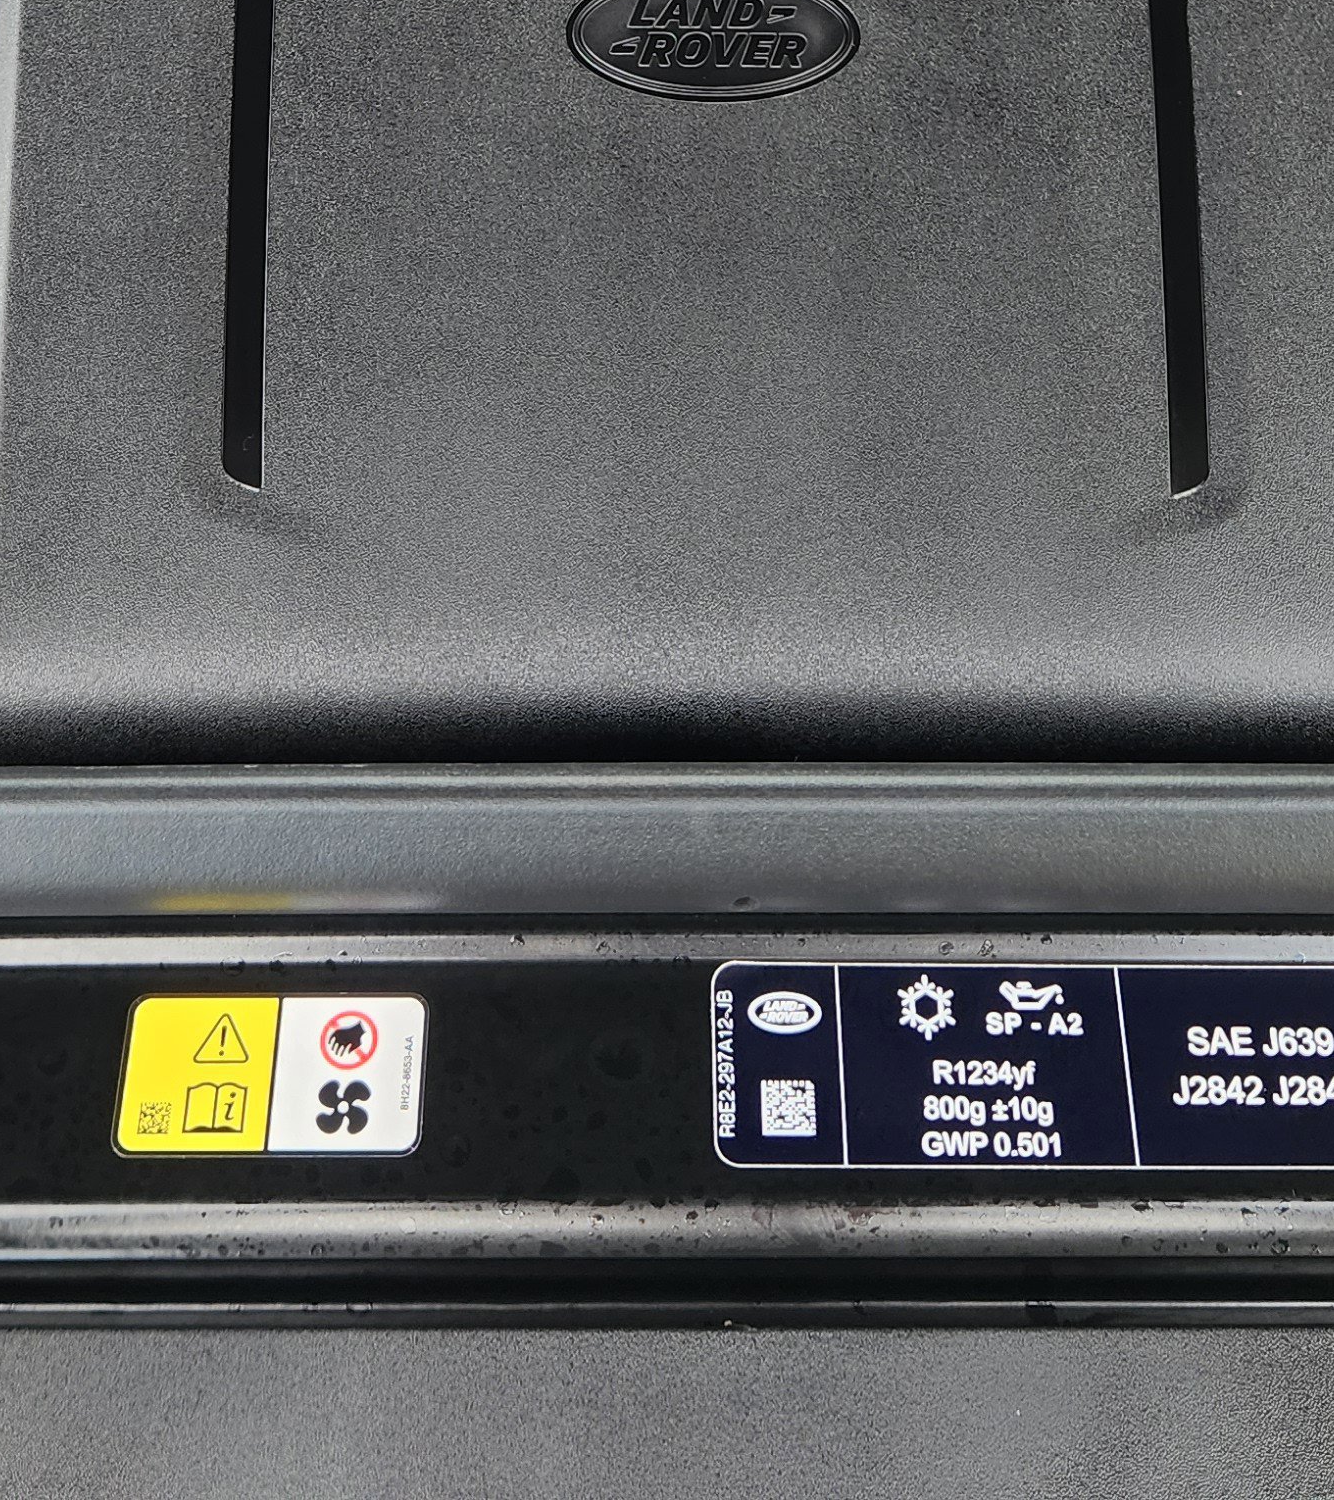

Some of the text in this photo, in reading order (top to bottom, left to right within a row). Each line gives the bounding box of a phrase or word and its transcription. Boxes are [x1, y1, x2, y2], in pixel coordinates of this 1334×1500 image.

[637, 31, 809, 69] ROVER
[762, 1000, 798, 1012] LAND
[765, 1011, 809, 1024] ROVER
[985, 1012, 1022, 1036] SP
[1047, 1011, 1085, 1036] A2
[1186, 1025, 1254, 1057] SAE
[715, 988, 737, 1138] R8E2-297A12-JB
[931, 1058, 1037, 1091] R1234yf
[1172, 1075, 1266, 1107] J2842
[922, 1095, 1054, 1127] 800g ±10g
[920, 1131, 1063, 1158] GWP 0.501
